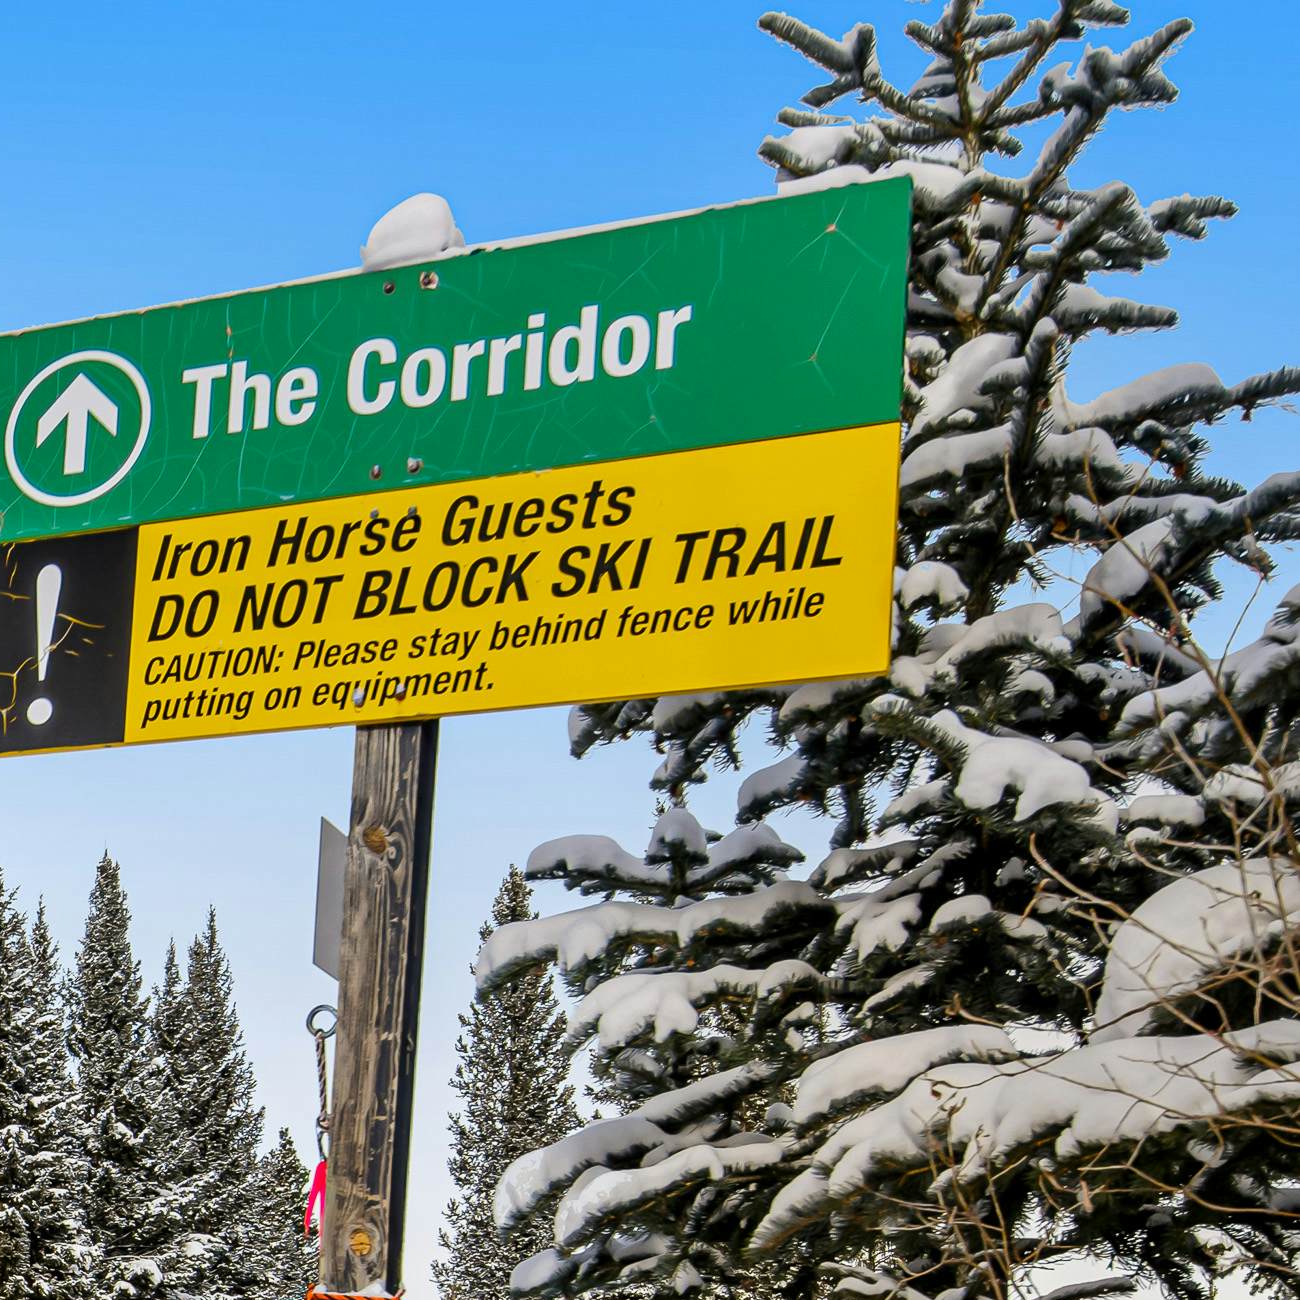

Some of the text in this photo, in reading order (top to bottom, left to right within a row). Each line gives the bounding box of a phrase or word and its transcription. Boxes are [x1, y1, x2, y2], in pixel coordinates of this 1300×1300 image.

[183, 305, 691, 438] The Corridor
[148, 515, 842, 642] DO NOT BLOCK SKI TRAIL
[152, 480, 635, 581] Iron Horse Guests
[145, 587, 824, 685] CAUTION: Please stay behind fence while
[141, 662, 494, 728] putting on equipment.
